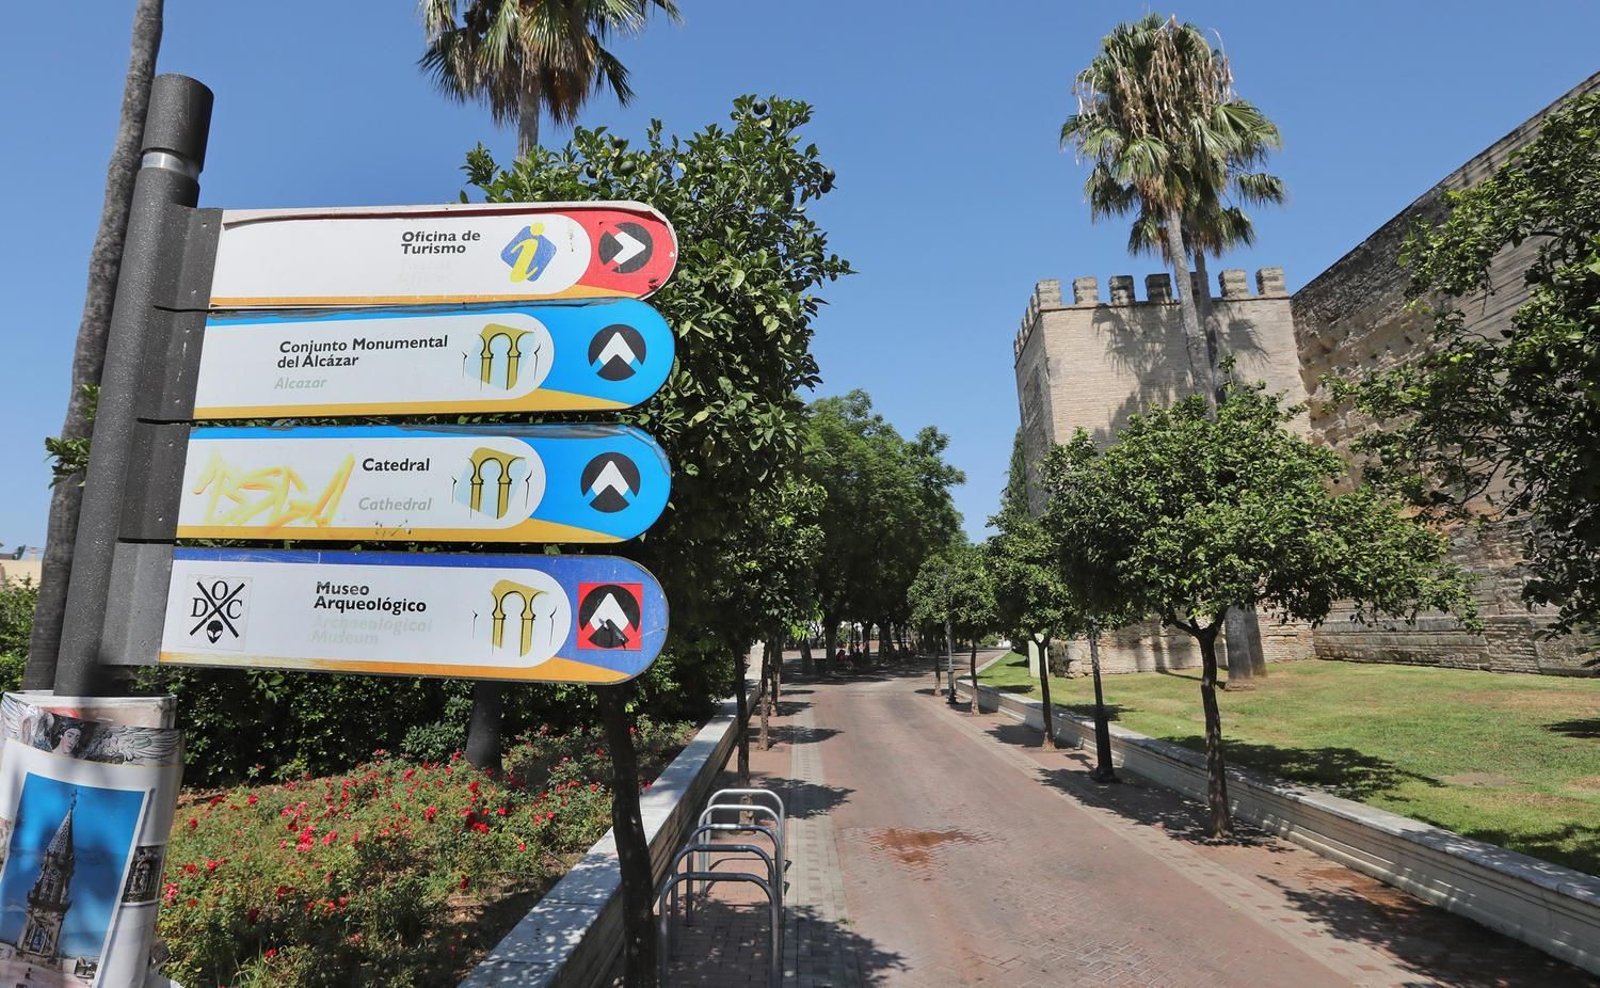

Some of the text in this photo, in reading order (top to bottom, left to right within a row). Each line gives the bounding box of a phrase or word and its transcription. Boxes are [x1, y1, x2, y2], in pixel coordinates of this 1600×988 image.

[401, 229, 481, 243] Oficina de
[401, 243, 467, 255] Turismo
[279, 335, 449, 355] Conjunto Monumental
[277, 354, 359, 368] del Alcázar
[274, 377, 327, 390] Alcazar
[362, 457, 430, 472] Catedral
[358, 497, 432, 511] Cathedral
[315, 581, 370, 596] Museo
[313, 595, 427, 616] Arqueológico
